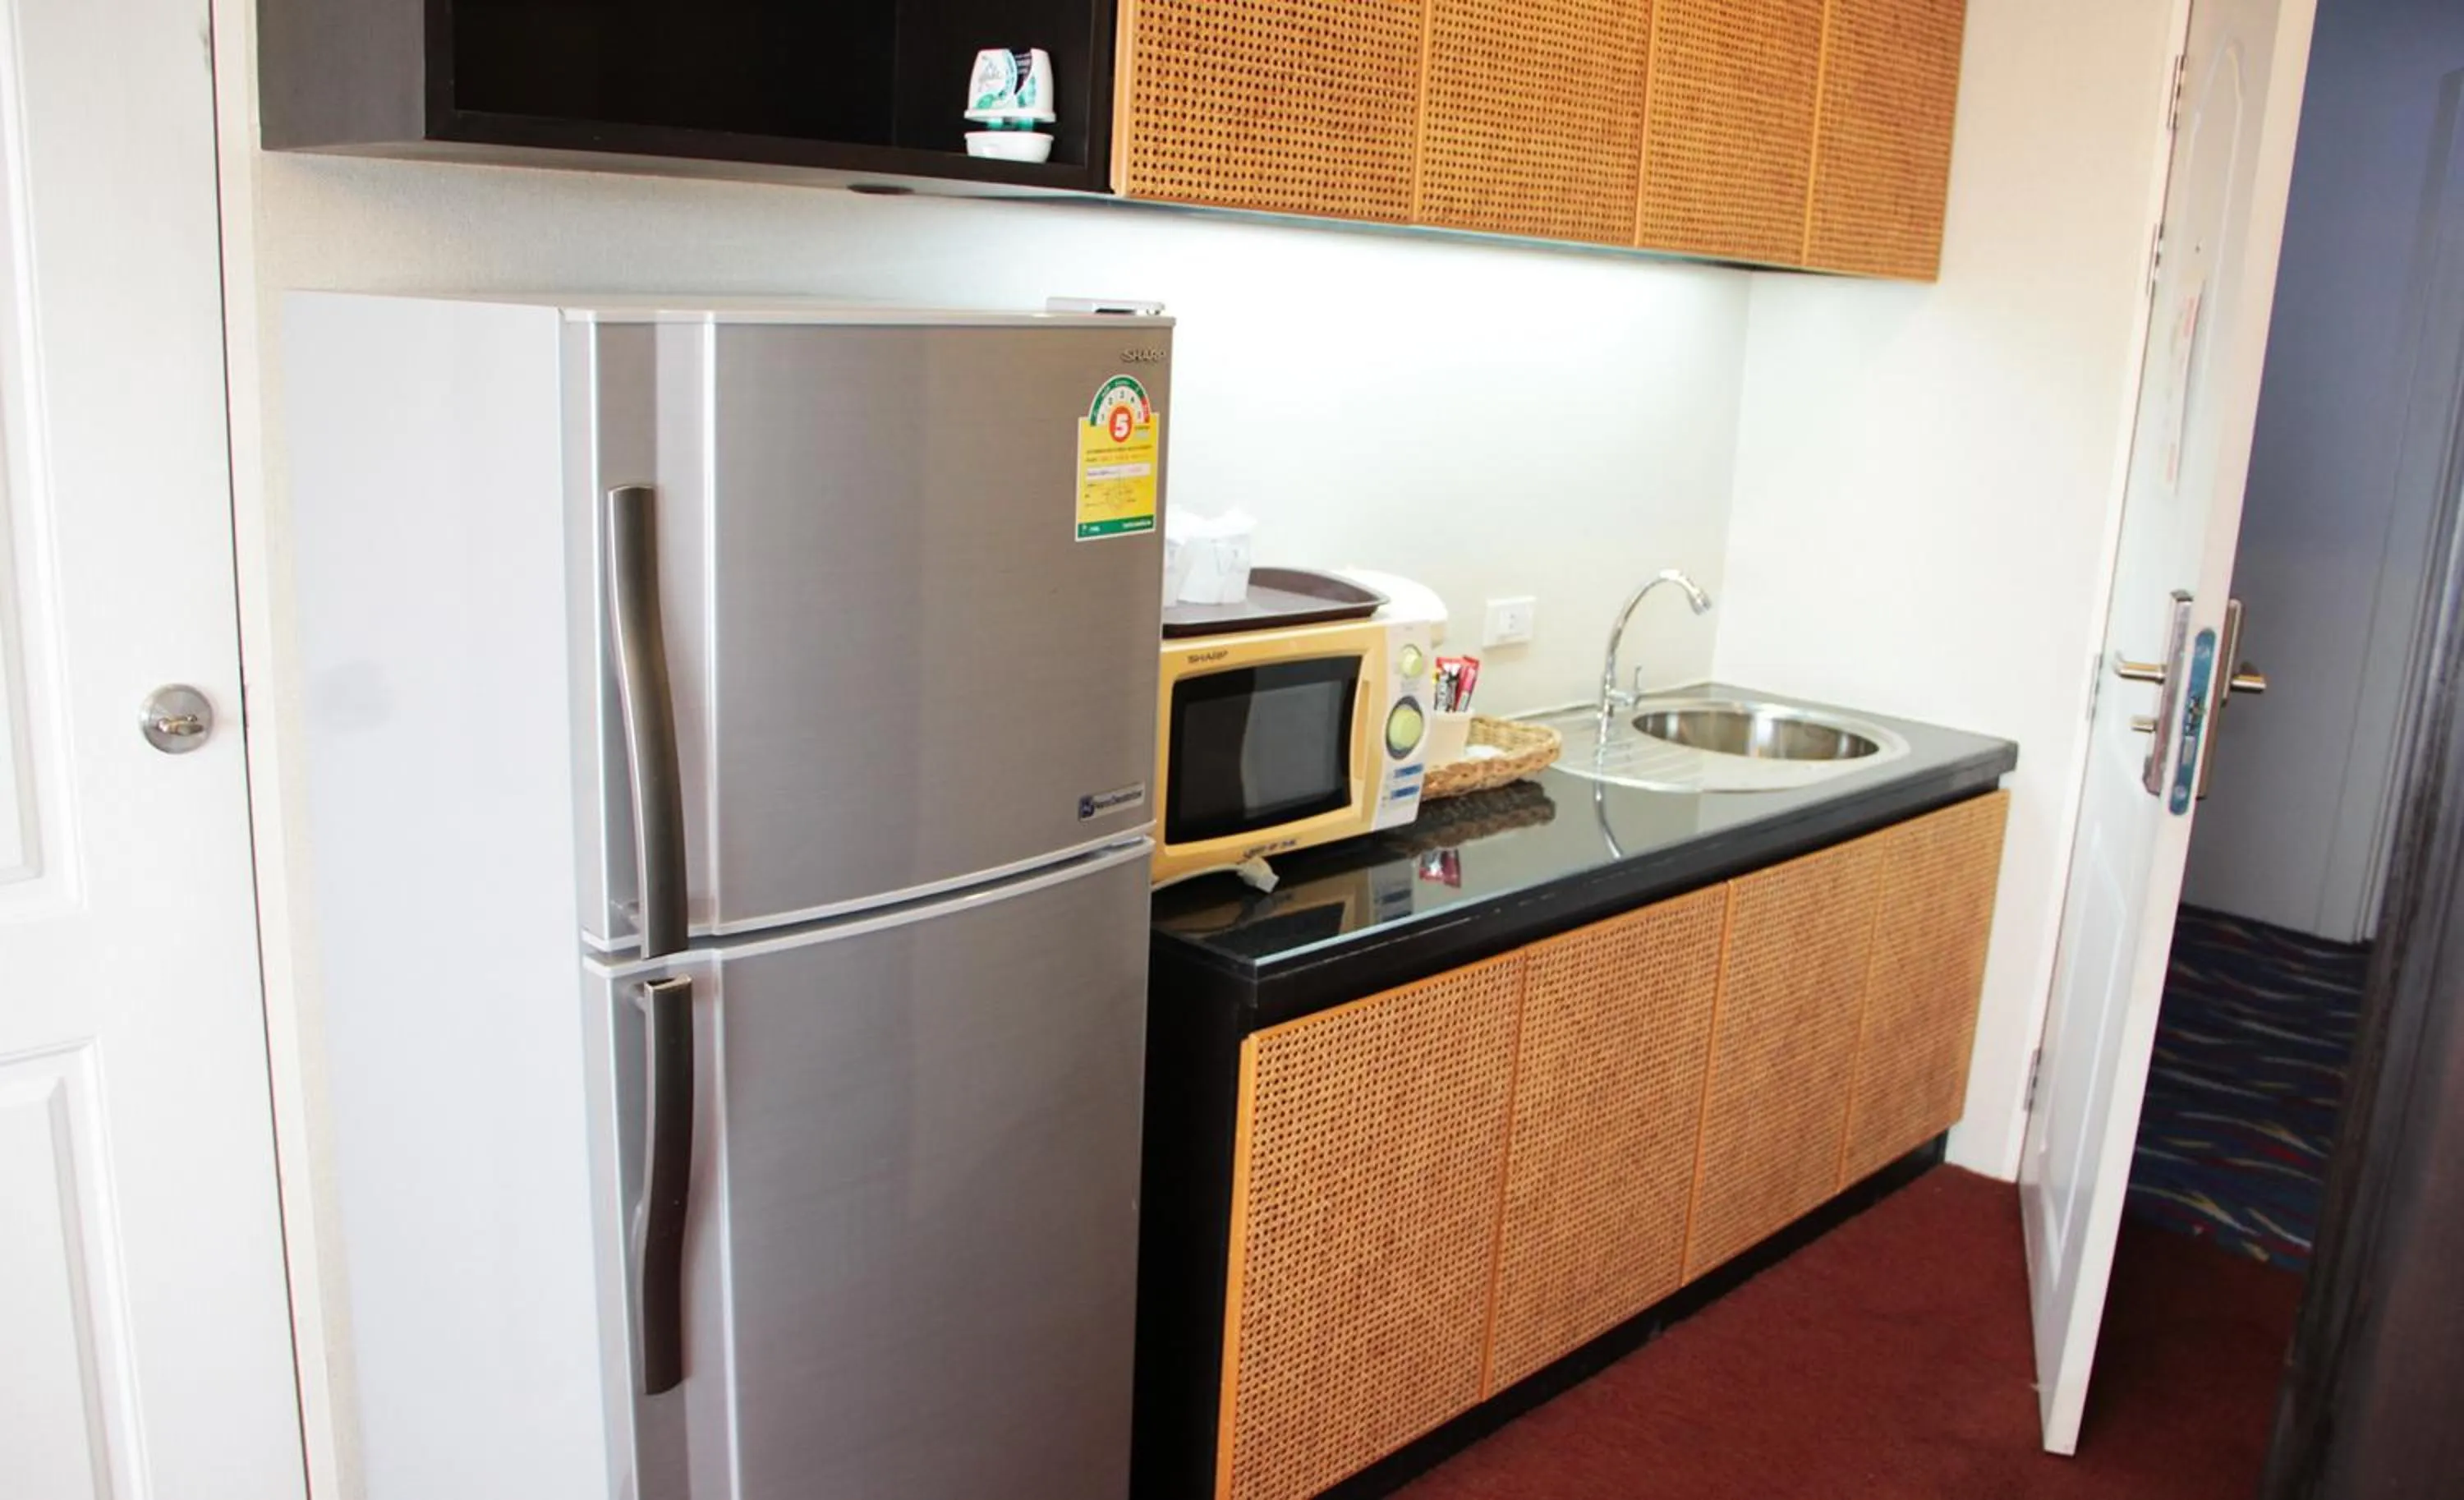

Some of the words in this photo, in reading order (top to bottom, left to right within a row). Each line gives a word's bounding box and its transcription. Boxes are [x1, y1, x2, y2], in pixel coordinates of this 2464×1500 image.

[1119, 348, 1166, 363] SHARP
[1114, 412, 1129, 439] 5
[1187, 650, 1229, 664] SHARP
